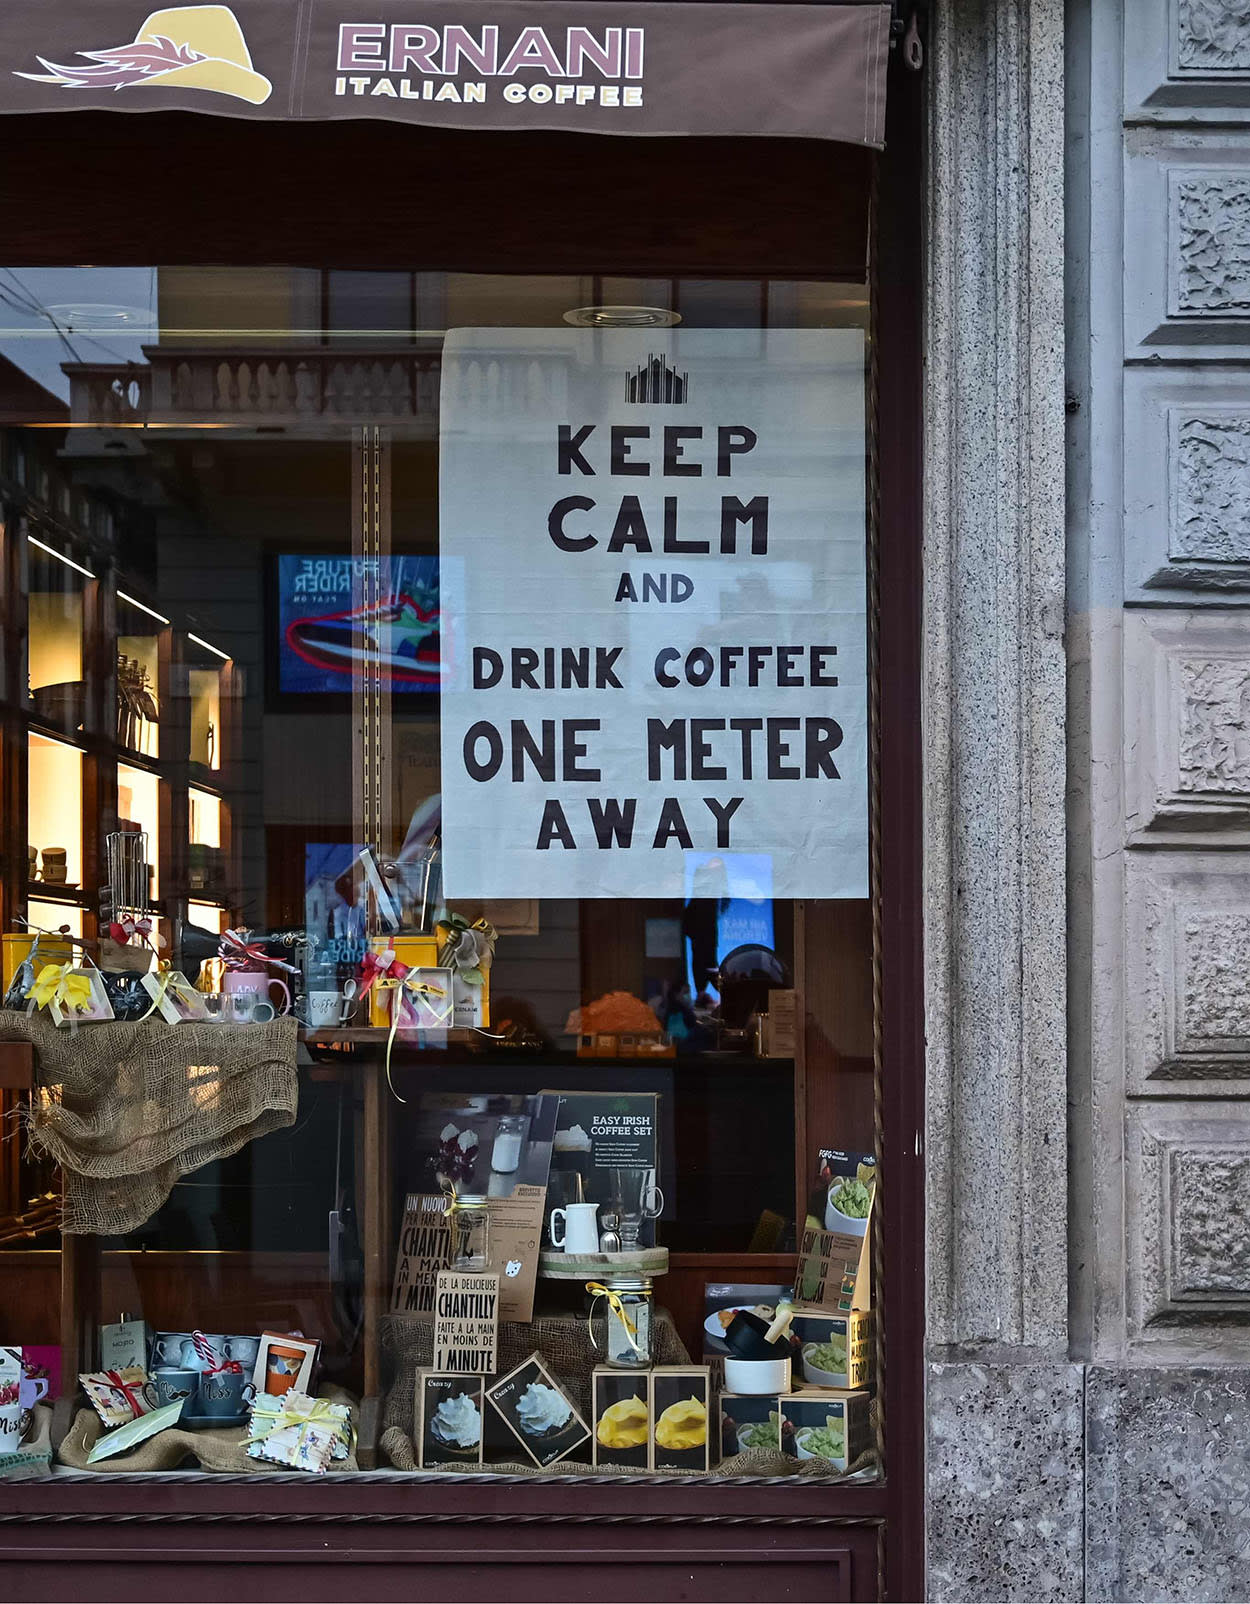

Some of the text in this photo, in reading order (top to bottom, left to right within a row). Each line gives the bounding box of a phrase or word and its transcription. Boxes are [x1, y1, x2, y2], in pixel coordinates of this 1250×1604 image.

[337, 23, 644, 79] ERNANI
[335, 77, 643, 106] ITALIAN COFFEE
[557, 424, 758, 477] KEEP
[548, 495, 769, 555] CALM
[614, 572, 695, 603] AND
[472, 646, 839, 690] DRINK COFFEE
[463, 717, 844, 783] ONE METER
[536, 798, 744, 850] AWAY
[312, 998, 338, 1014] Coffee
[593, 1116, 650, 1126] EASY IRISH
[590, 1126, 652, 1136] COFFEE SET
[406, 1196, 447, 1212] UN NUOVO
[405, 1212, 419, 1225] PER
[421, 1213, 436, 1226] FARE
[400, 1258, 451, 1272] A MAN
[399, 1271, 409, 1284] IN
[440, 1278, 496, 1290] DE LA DELICIEUSE
[438, 1293, 496, 1319] CHANTILLY
[438, 1321, 495, 1335] FAITE A LA MAIN
[437, 1334, 494, 1346] EN MOINS DE
[437, 1349, 493, 1372] 1 MINUTE
